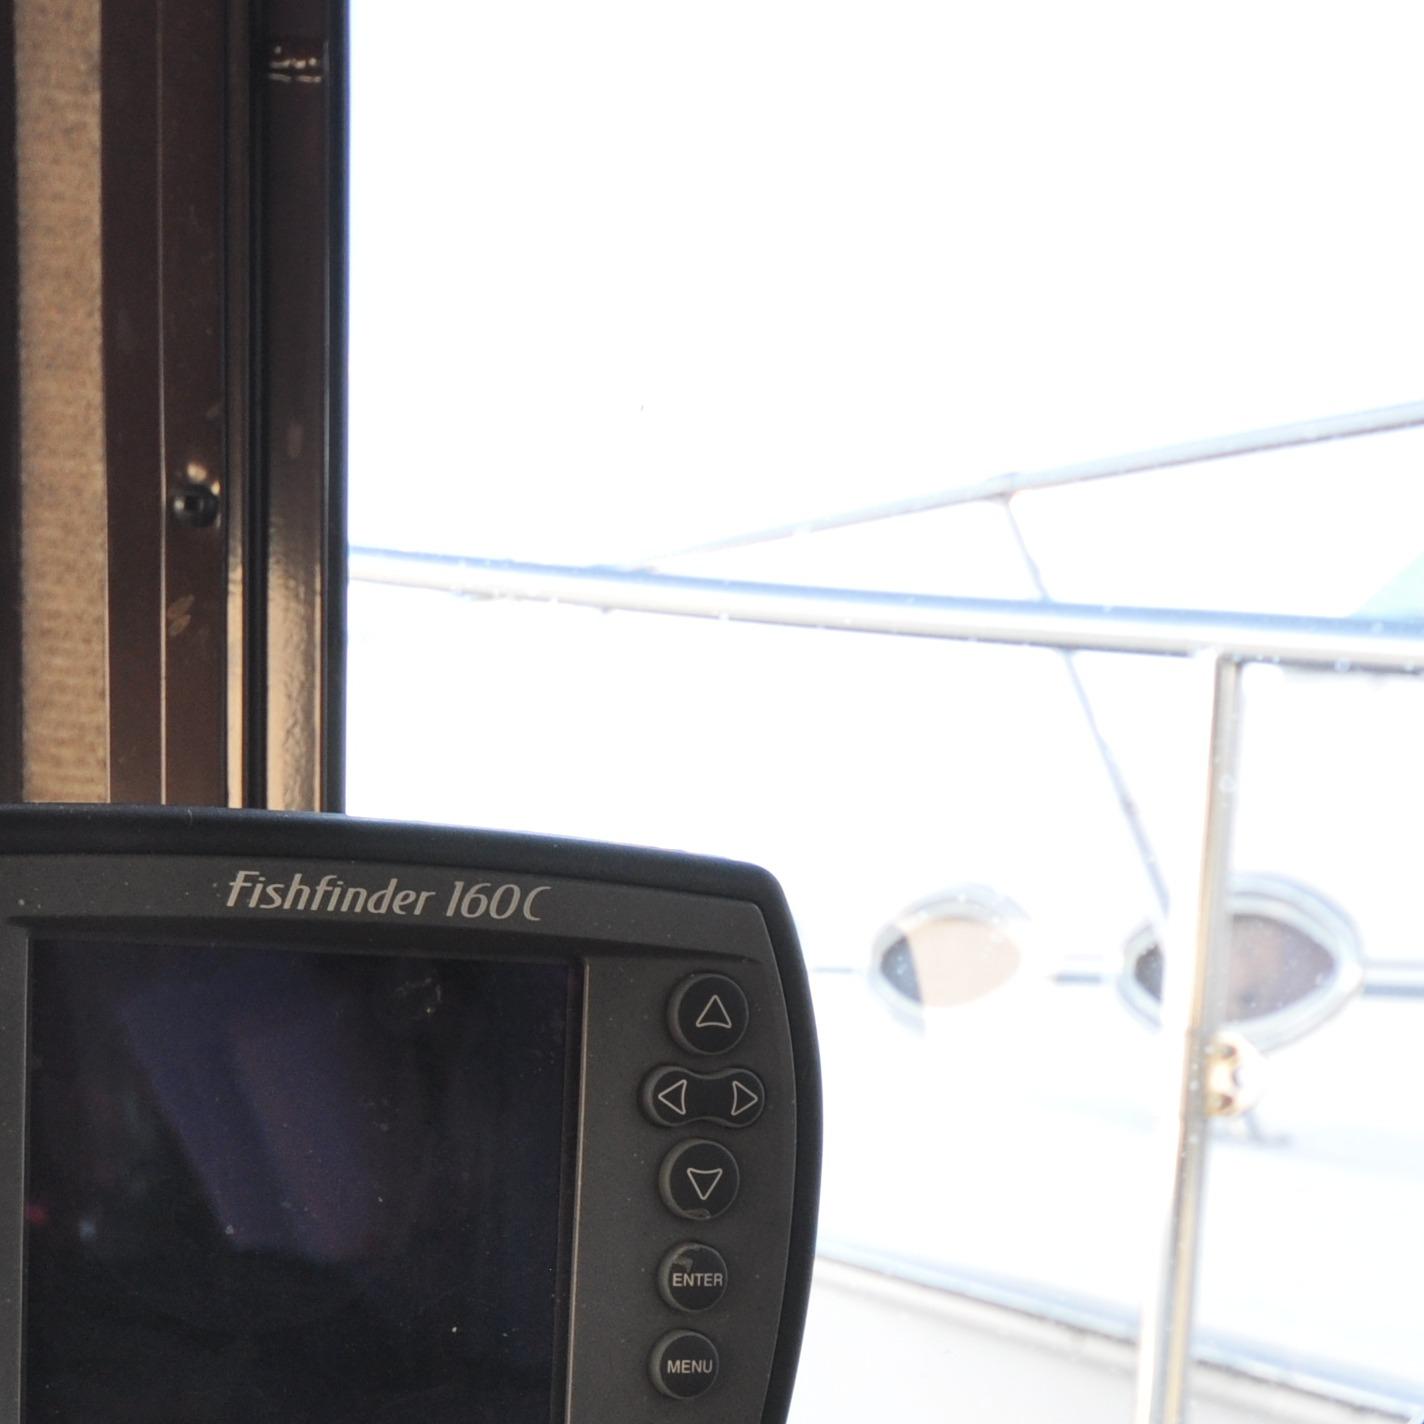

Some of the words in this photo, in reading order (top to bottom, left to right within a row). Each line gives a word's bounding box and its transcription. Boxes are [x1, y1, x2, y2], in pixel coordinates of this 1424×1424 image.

[226, 870, 435, 916] Fishfinder
[445, 880, 552, 921] 160C
[672, 1272, 724, 1287] ENTER
[666, 1359, 713, 1374] MENU
